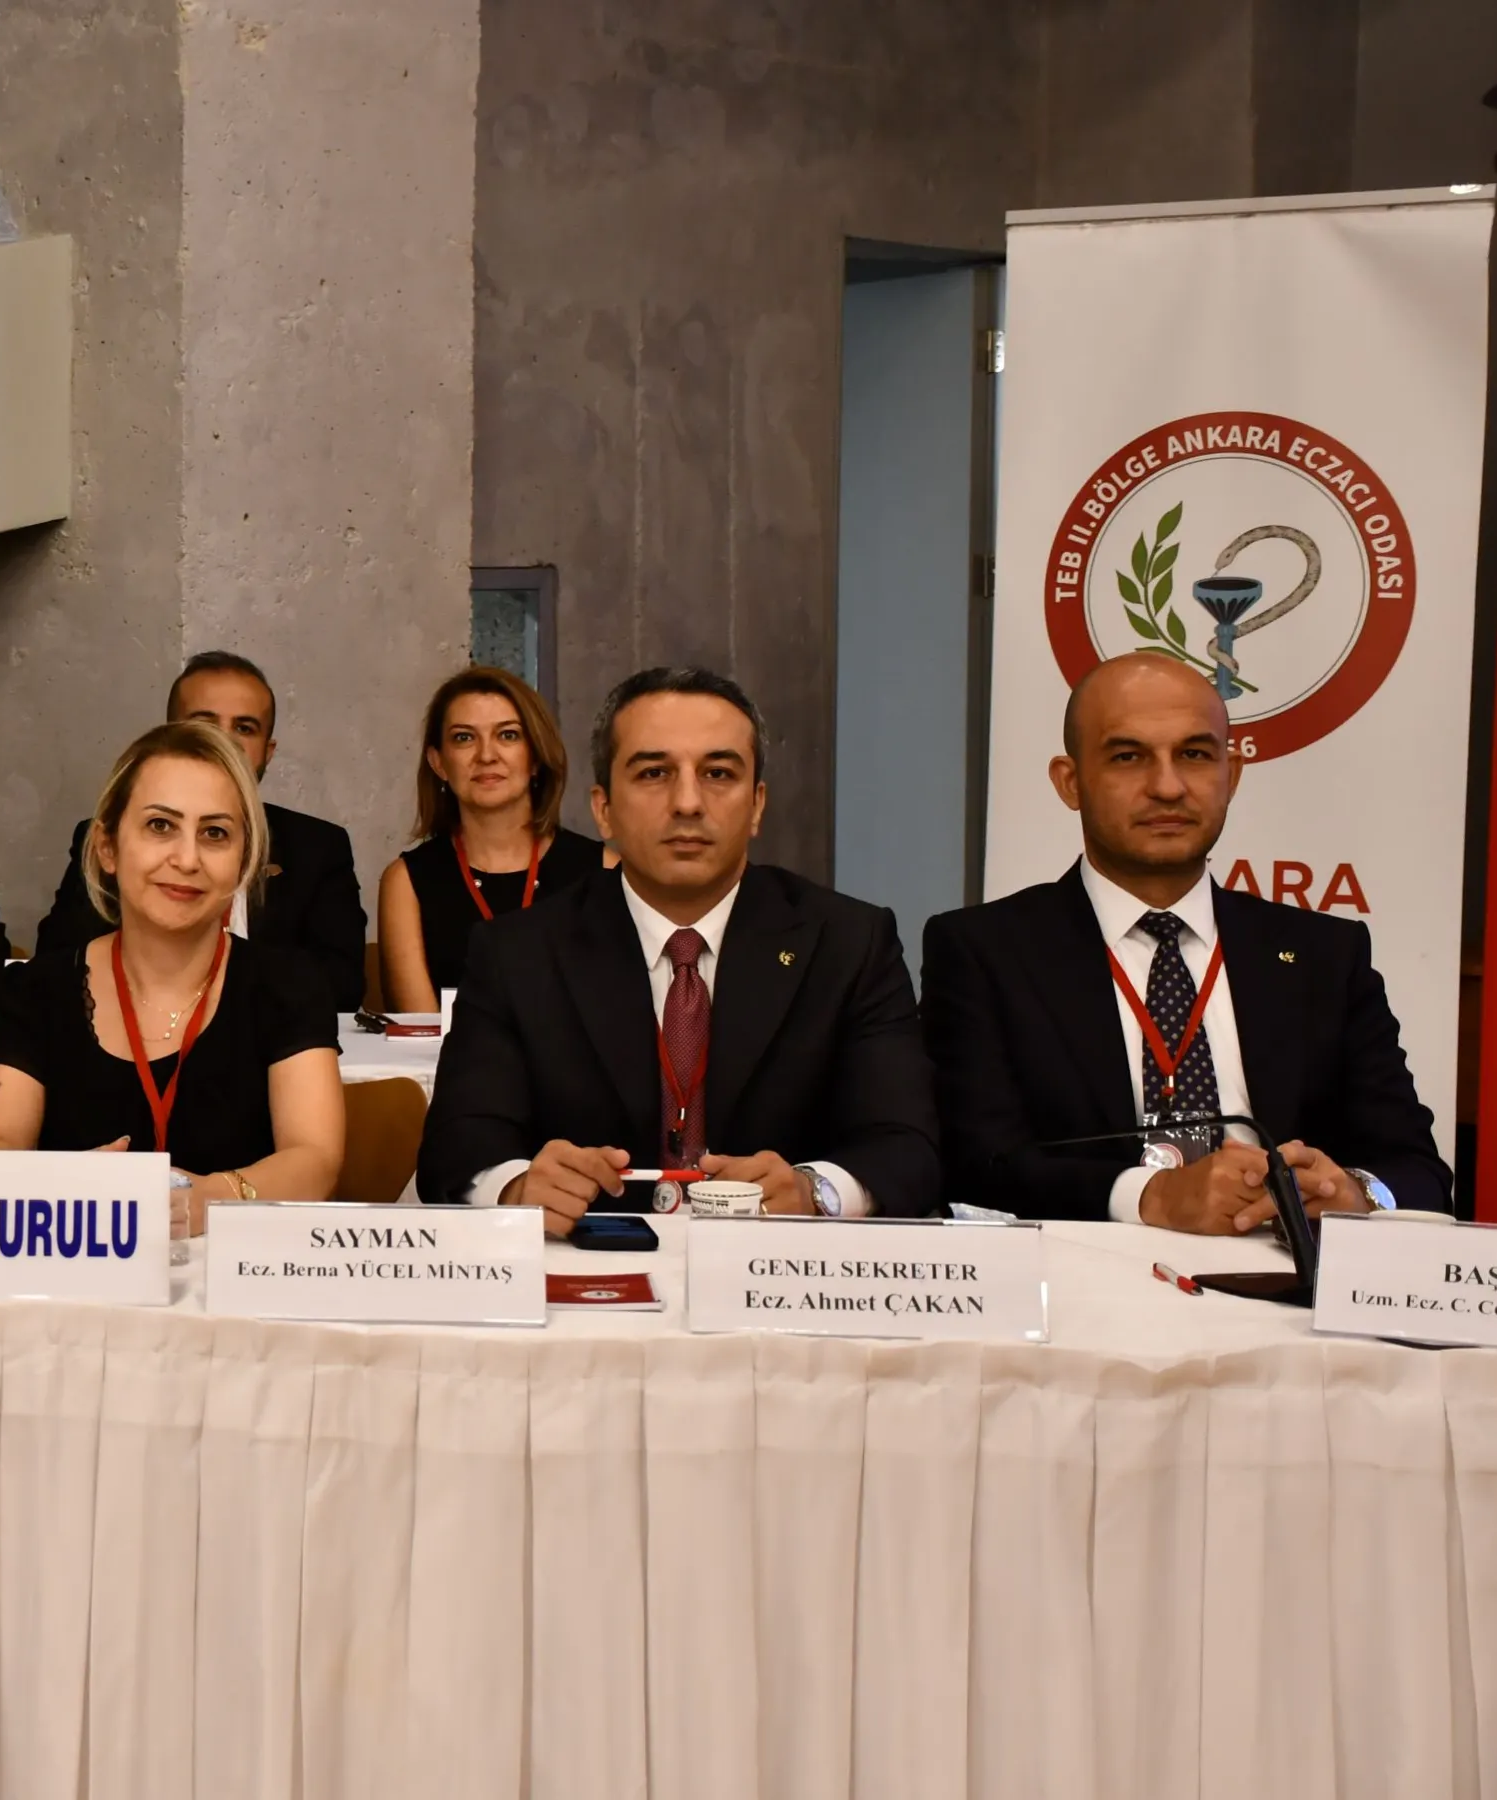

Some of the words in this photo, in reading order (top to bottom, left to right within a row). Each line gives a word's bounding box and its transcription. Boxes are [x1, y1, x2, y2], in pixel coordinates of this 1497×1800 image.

[1055, 550, 1083, 603] TEB
[1167, 425, 1282, 460] ANKARA
[1286, 436, 1378, 513] ECZACI
[1364, 513, 1404, 600] ODASI
[1205, 857, 1371, 914] ARA
[310, 1227, 438, 1249] SAYMAN
[237, 1261, 276, 1277] Ecz.
[282, 1262, 339, 1278] Berna
[344, 1259, 422, 1279] YÜCEL
[426, 1259, 513, 1284] MİNTAŞ
[748, 1259, 835, 1278] GENEL
[840, 1261, 978, 1281] SEKRETER
[745, 1290, 792, 1310] Ecz.
[799, 1292, 876, 1312] Ahmet
[884, 1294, 984, 1317] ÇAKAN
[1352, 1290, 1398, 1308] Uzm.
[1406, 1294, 1444, 1311] Ecz.
[1450, 1298, 1471, 1313] C.
